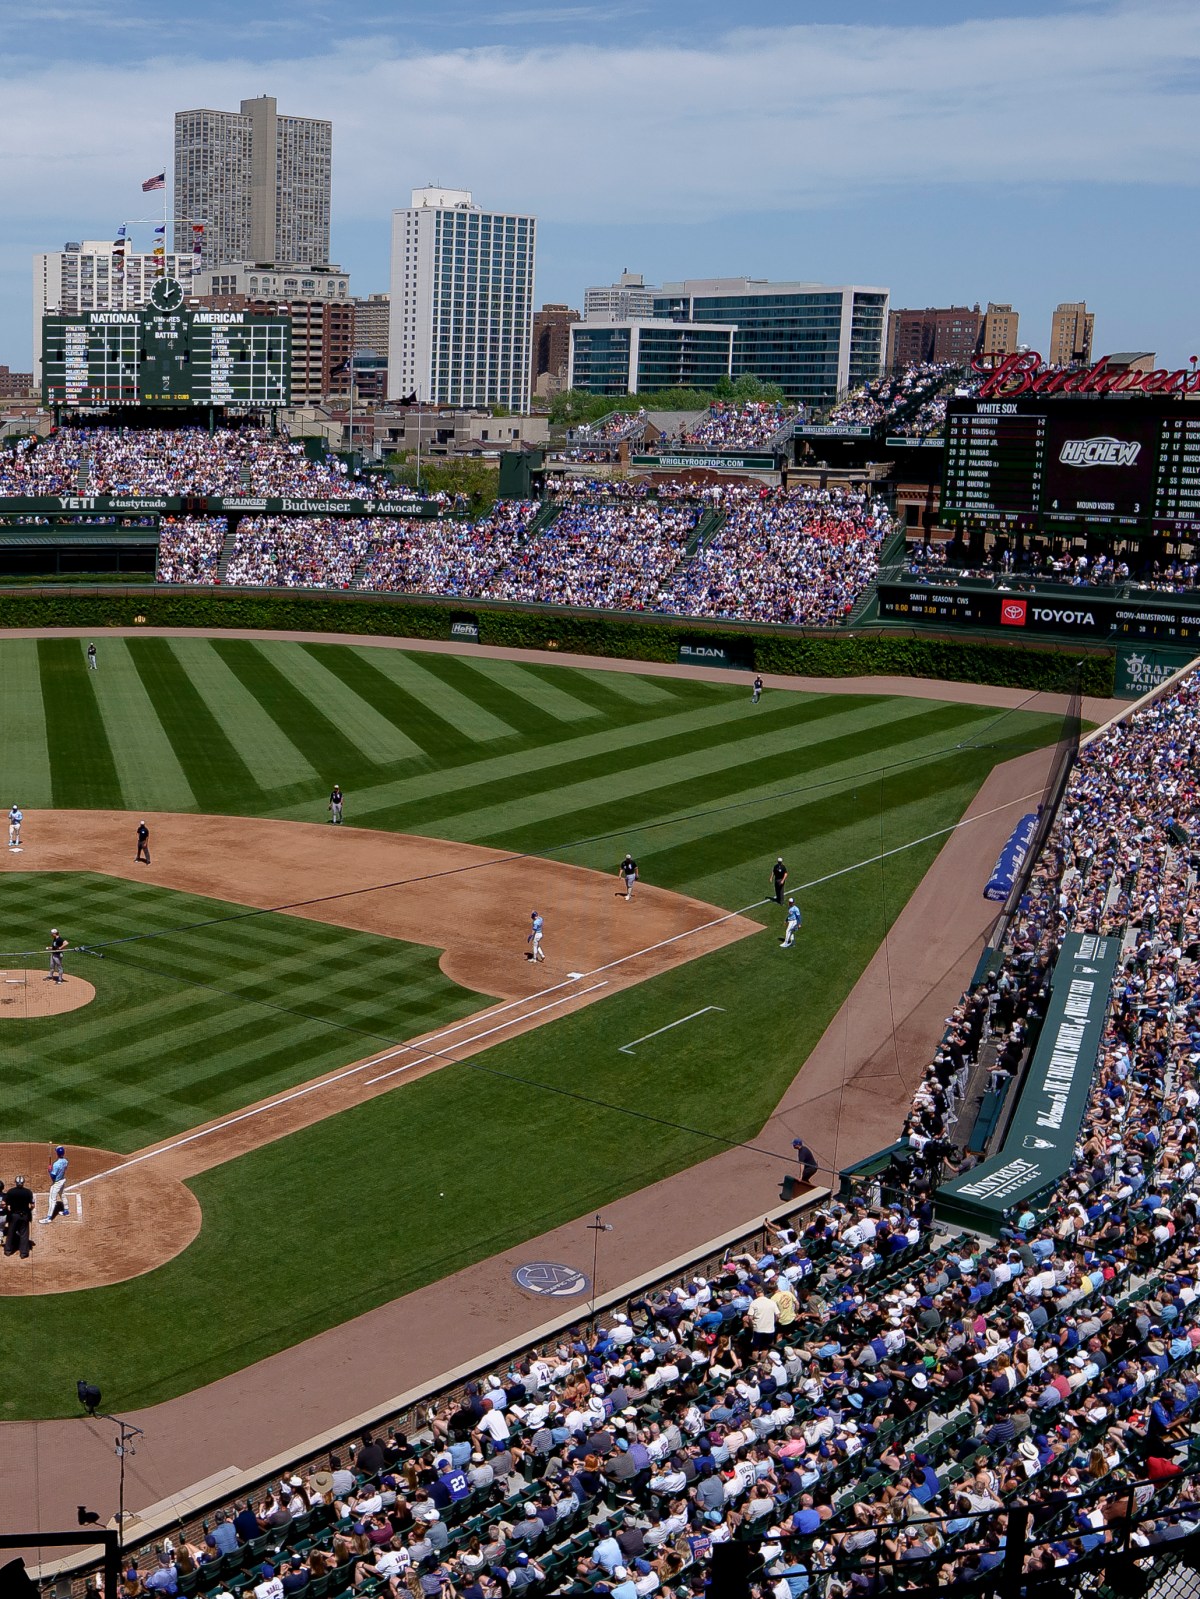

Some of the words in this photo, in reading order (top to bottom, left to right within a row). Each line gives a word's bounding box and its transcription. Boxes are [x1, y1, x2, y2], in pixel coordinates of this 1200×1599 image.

[90, 313, 141, 323] NATIONAL
[192, 313, 244, 323] AMERICAN
[155, 331, 179, 339] BATTER
[167, 340, 174, 350] 4
[163, 381, 170, 390] 2
[977, 404, 1000, 413] WHITE
[1001, 404, 1017, 414] SOX
[1059, 440, 1141, 466] HI-CHEW
[659, 457, 744, 468] WRIGLEYROOFTOPS.COM
[58, 498, 95, 509] YETI
[115, 500, 167, 510] tastytrade
[222, 498, 267, 506] GRAINGER
[282, 500, 347, 511] Budweiser
[377, 502, 422, 513] Advocate
[1052, 500, 1058, 508] 4
[1134, 504, 1140, 513] 3
[909, 593, 927, 601] SMITH
[932, 595, 953, 604] SEASON
[956, 597, 969, 605] CWS
[1031, 608, 1095, 626] TOYOTA
[1116, 610, 1175, 622] CROW-ARMSTRONG
[453, 624, 477, 635] Hefty
[680, 645, 724, 658] SLOAN
[1054, 1022, 1085, 1052] CONFINES
[1046, 1049, 1078, 1081] FRIENDLY
[1042, 1079, 1071, 1094] THE
[957, 1158, 1033, 1197] WINTRUST
[993, 1171, 1042, 1198] MORTGAGE
[450, 1475, 466, 1492] 23
[745, 1474, 756, 1486] 21
